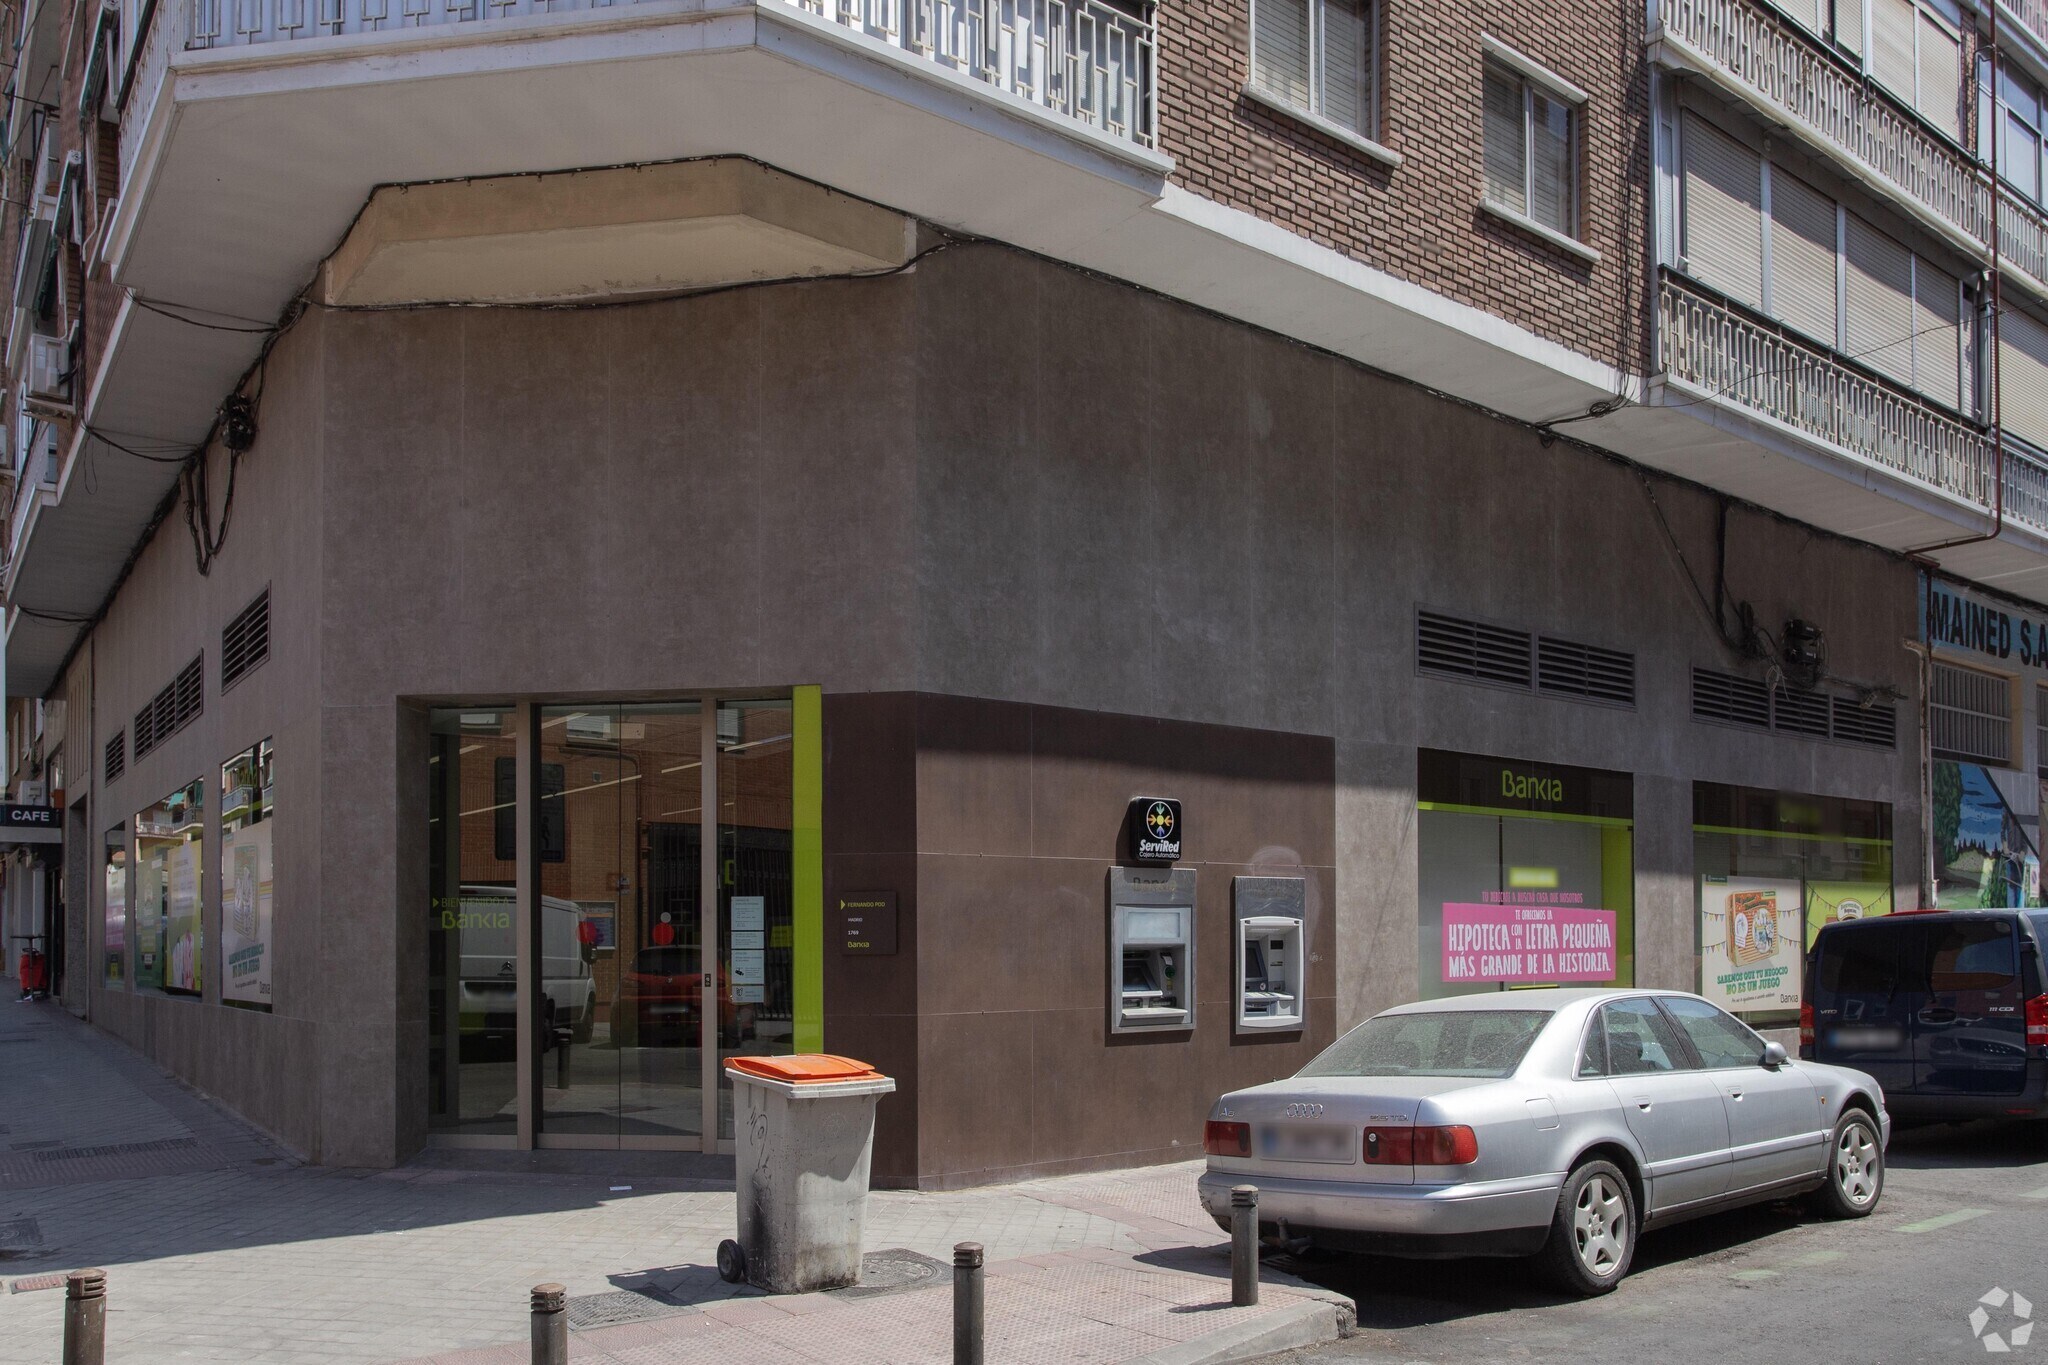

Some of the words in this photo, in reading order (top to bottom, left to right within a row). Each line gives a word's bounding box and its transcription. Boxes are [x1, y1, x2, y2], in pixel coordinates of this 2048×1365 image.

[1931, 591, 2011, 659] MAINED
[1502, 770, 1563, 802] Bankia
[11, 810, 50, 822] CAFE
[1139, 839, 1180, 853] ServiRed
[441, 910, 510, 929] Bankia
[1515, 909, 1521, 920] TE
[1547, 909, 1553, 920] LA
[1448, 923, 1511, 951] HIPOTECA
[1511, 924, 1523, 936] CON
[1525, 923, 1559, 950] LETRA
[1562, 919, 1611, 948] PEQUEÑA
[1515, 938, 1523, 950] LA
[1448, 951, 1476, 977] MÁS
[1481, 954, 1523, 977] GRANDE
[1527, 954, 1538, 974] DE
[1542, 953, 1555, 974] LA
[1559, 952, 1611, 973] HISTORIA.
[1717, 973, 1743, 984] SABEMOS
[1743, 970, 1755, 981] QUE
[1756, 969, 1763, 979] TU
[1764, 965, 1789, 977] NEGOCIO
[1726, 983, 1737, 995] NO
[1738, 981, 1746, 993] ES
[1746, 980, 1758, 991] UN
[1758, 976, 1781, 990] JUEGO
[1780, 993, 1799, 1004] Bankia
